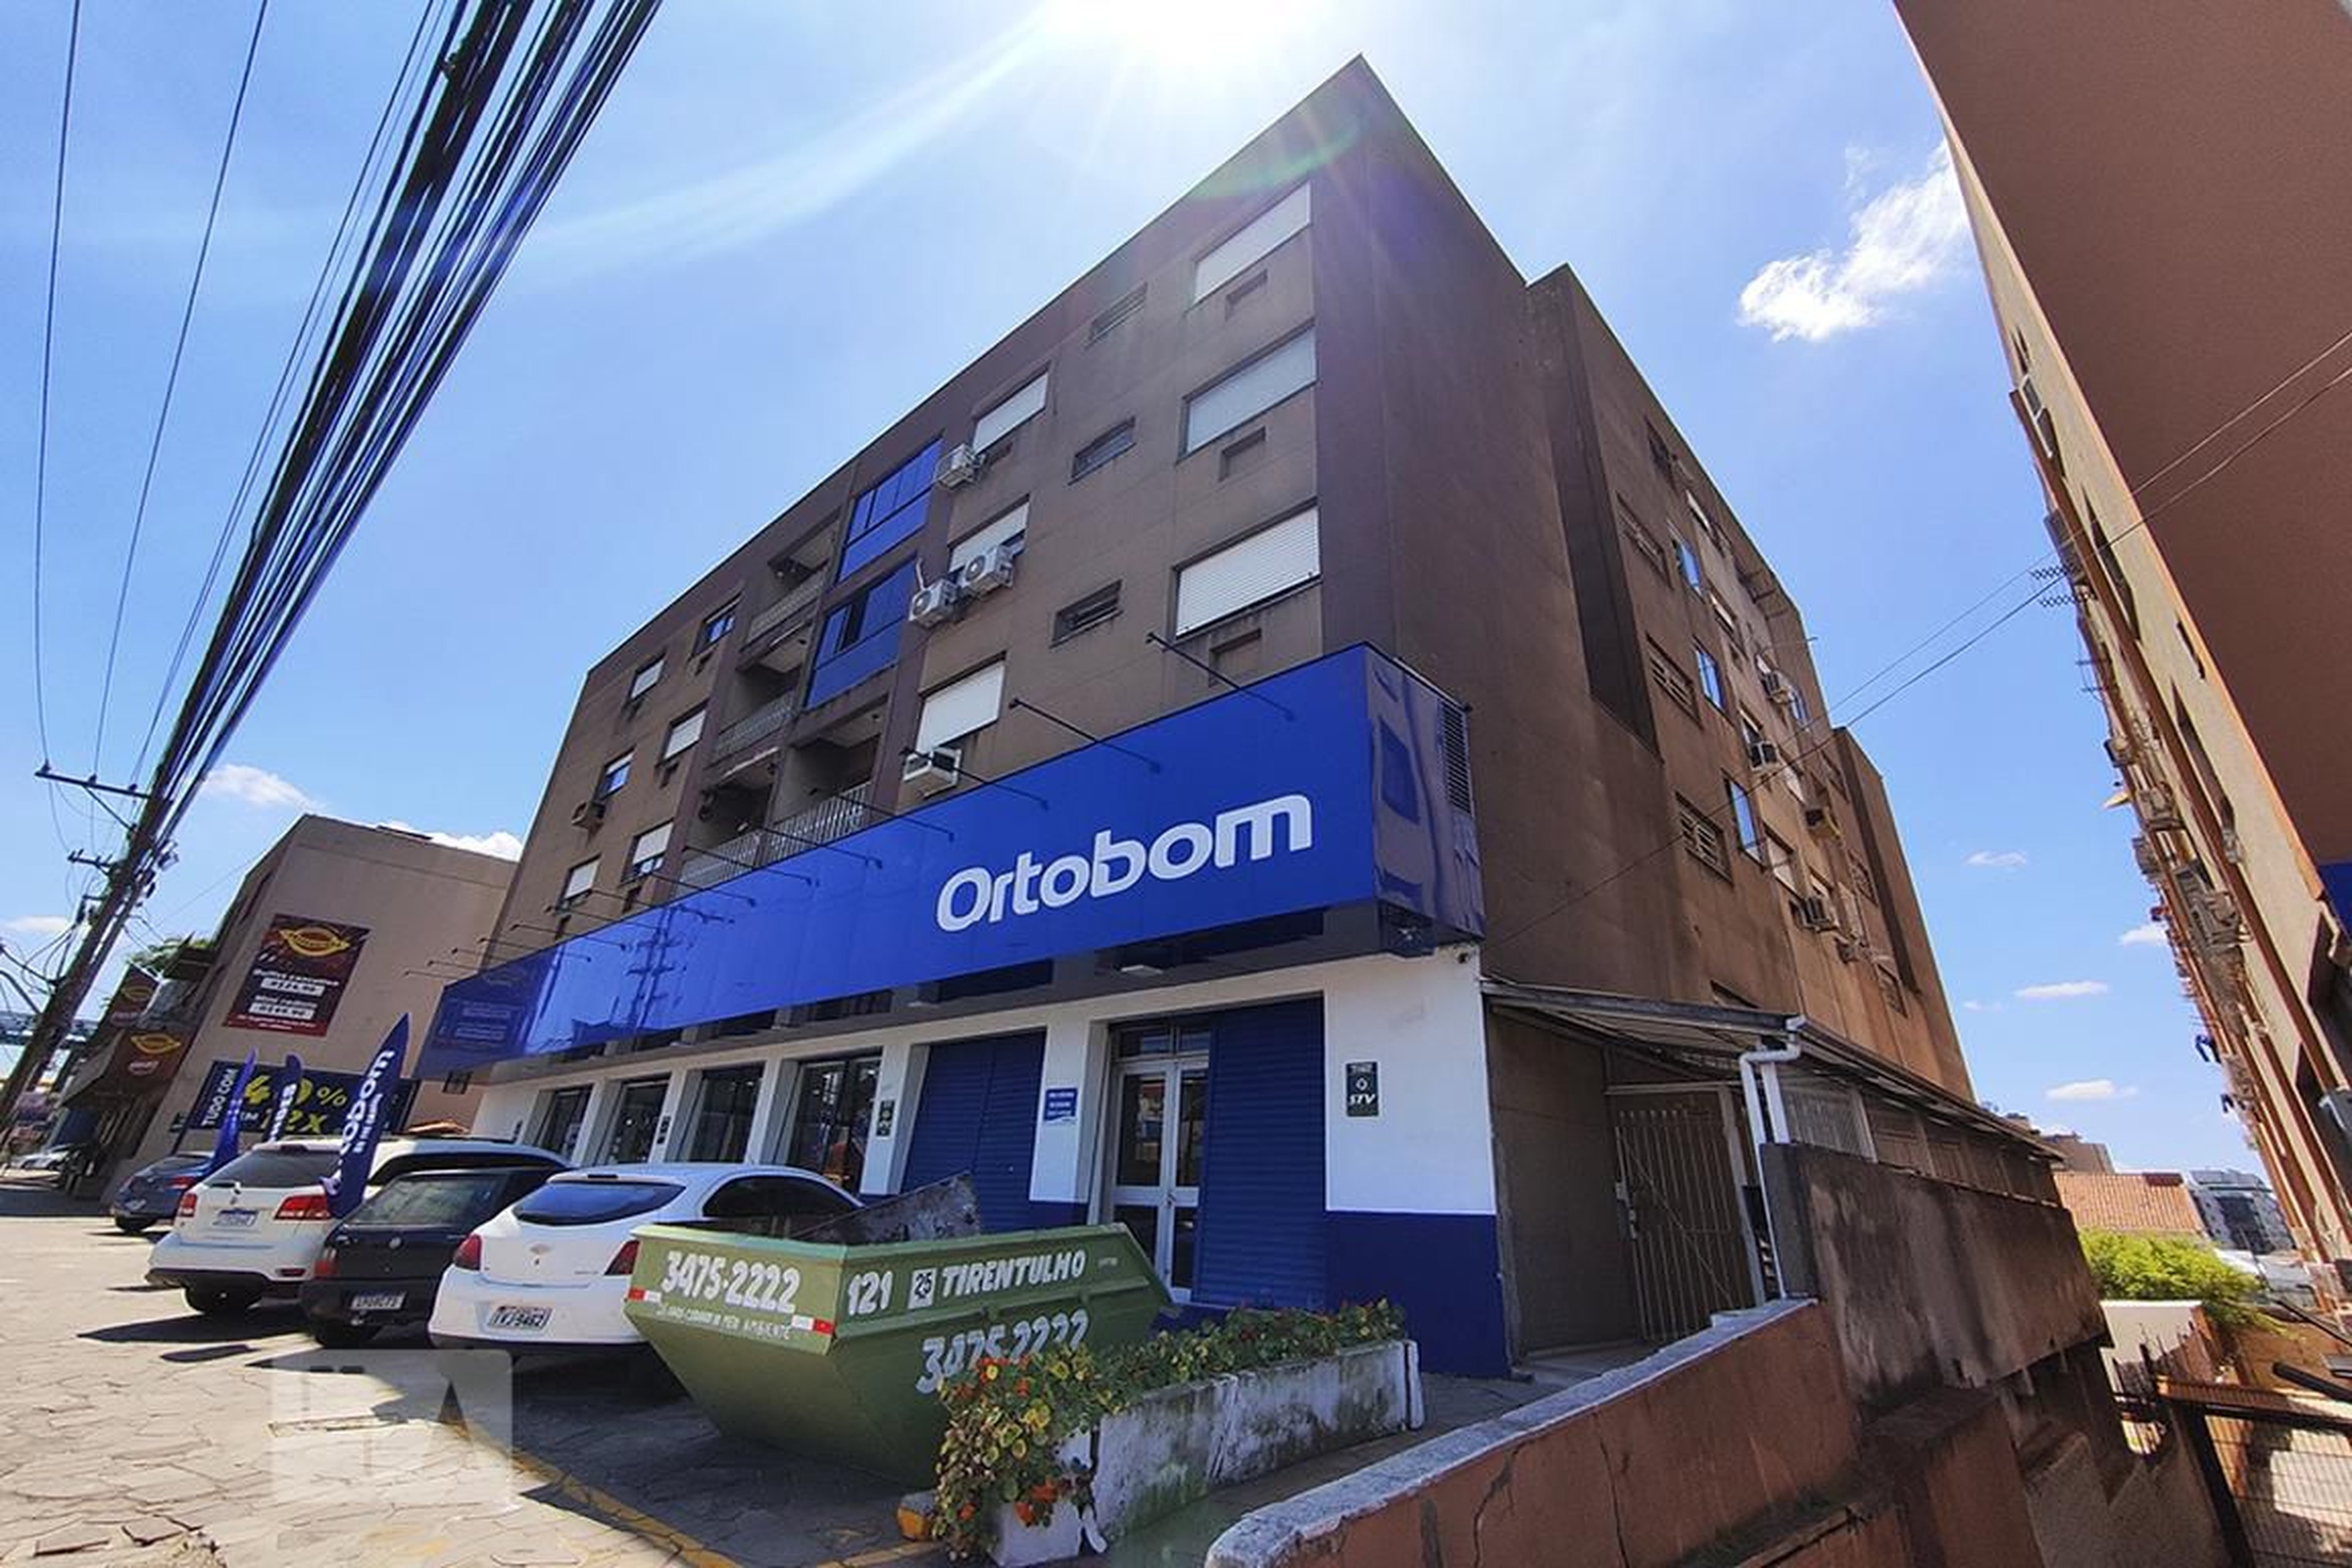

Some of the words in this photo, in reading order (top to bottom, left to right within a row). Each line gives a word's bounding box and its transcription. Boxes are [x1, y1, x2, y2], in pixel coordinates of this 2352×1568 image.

[937, 794, 1312, 932] Ortobom
[201, 1095, 226, 1126] TUDO
[217, 1068, 239, 1095] COM
[848, 1270, 894, 1316] 121
[942, 1248, 1086, 1298] TIRENTULHO
